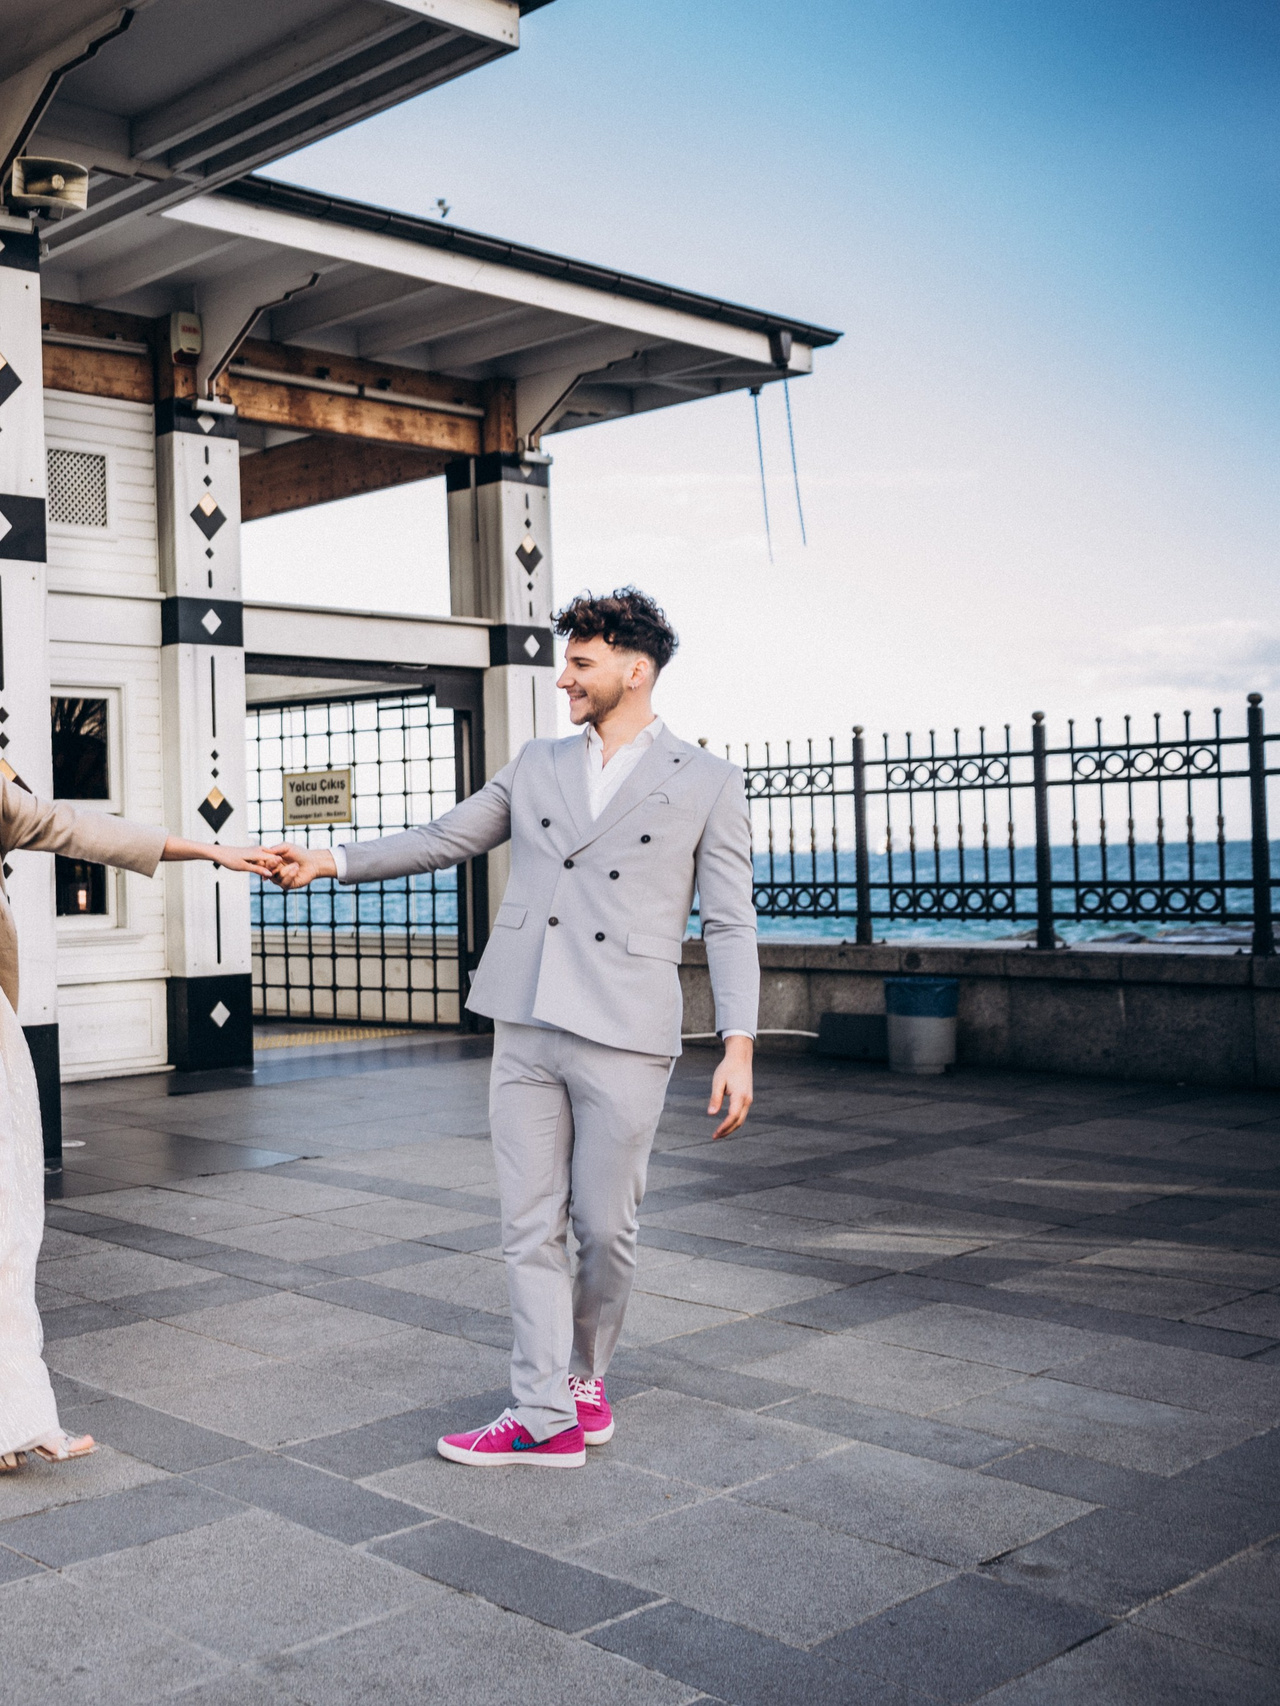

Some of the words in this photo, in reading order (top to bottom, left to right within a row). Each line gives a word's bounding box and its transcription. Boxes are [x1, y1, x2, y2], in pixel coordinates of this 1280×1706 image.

[289, 781, 317, 793] Yolcu
[320, 778, 346, 792] Çıkış
[295, 794, 339, 807] Girilmez
